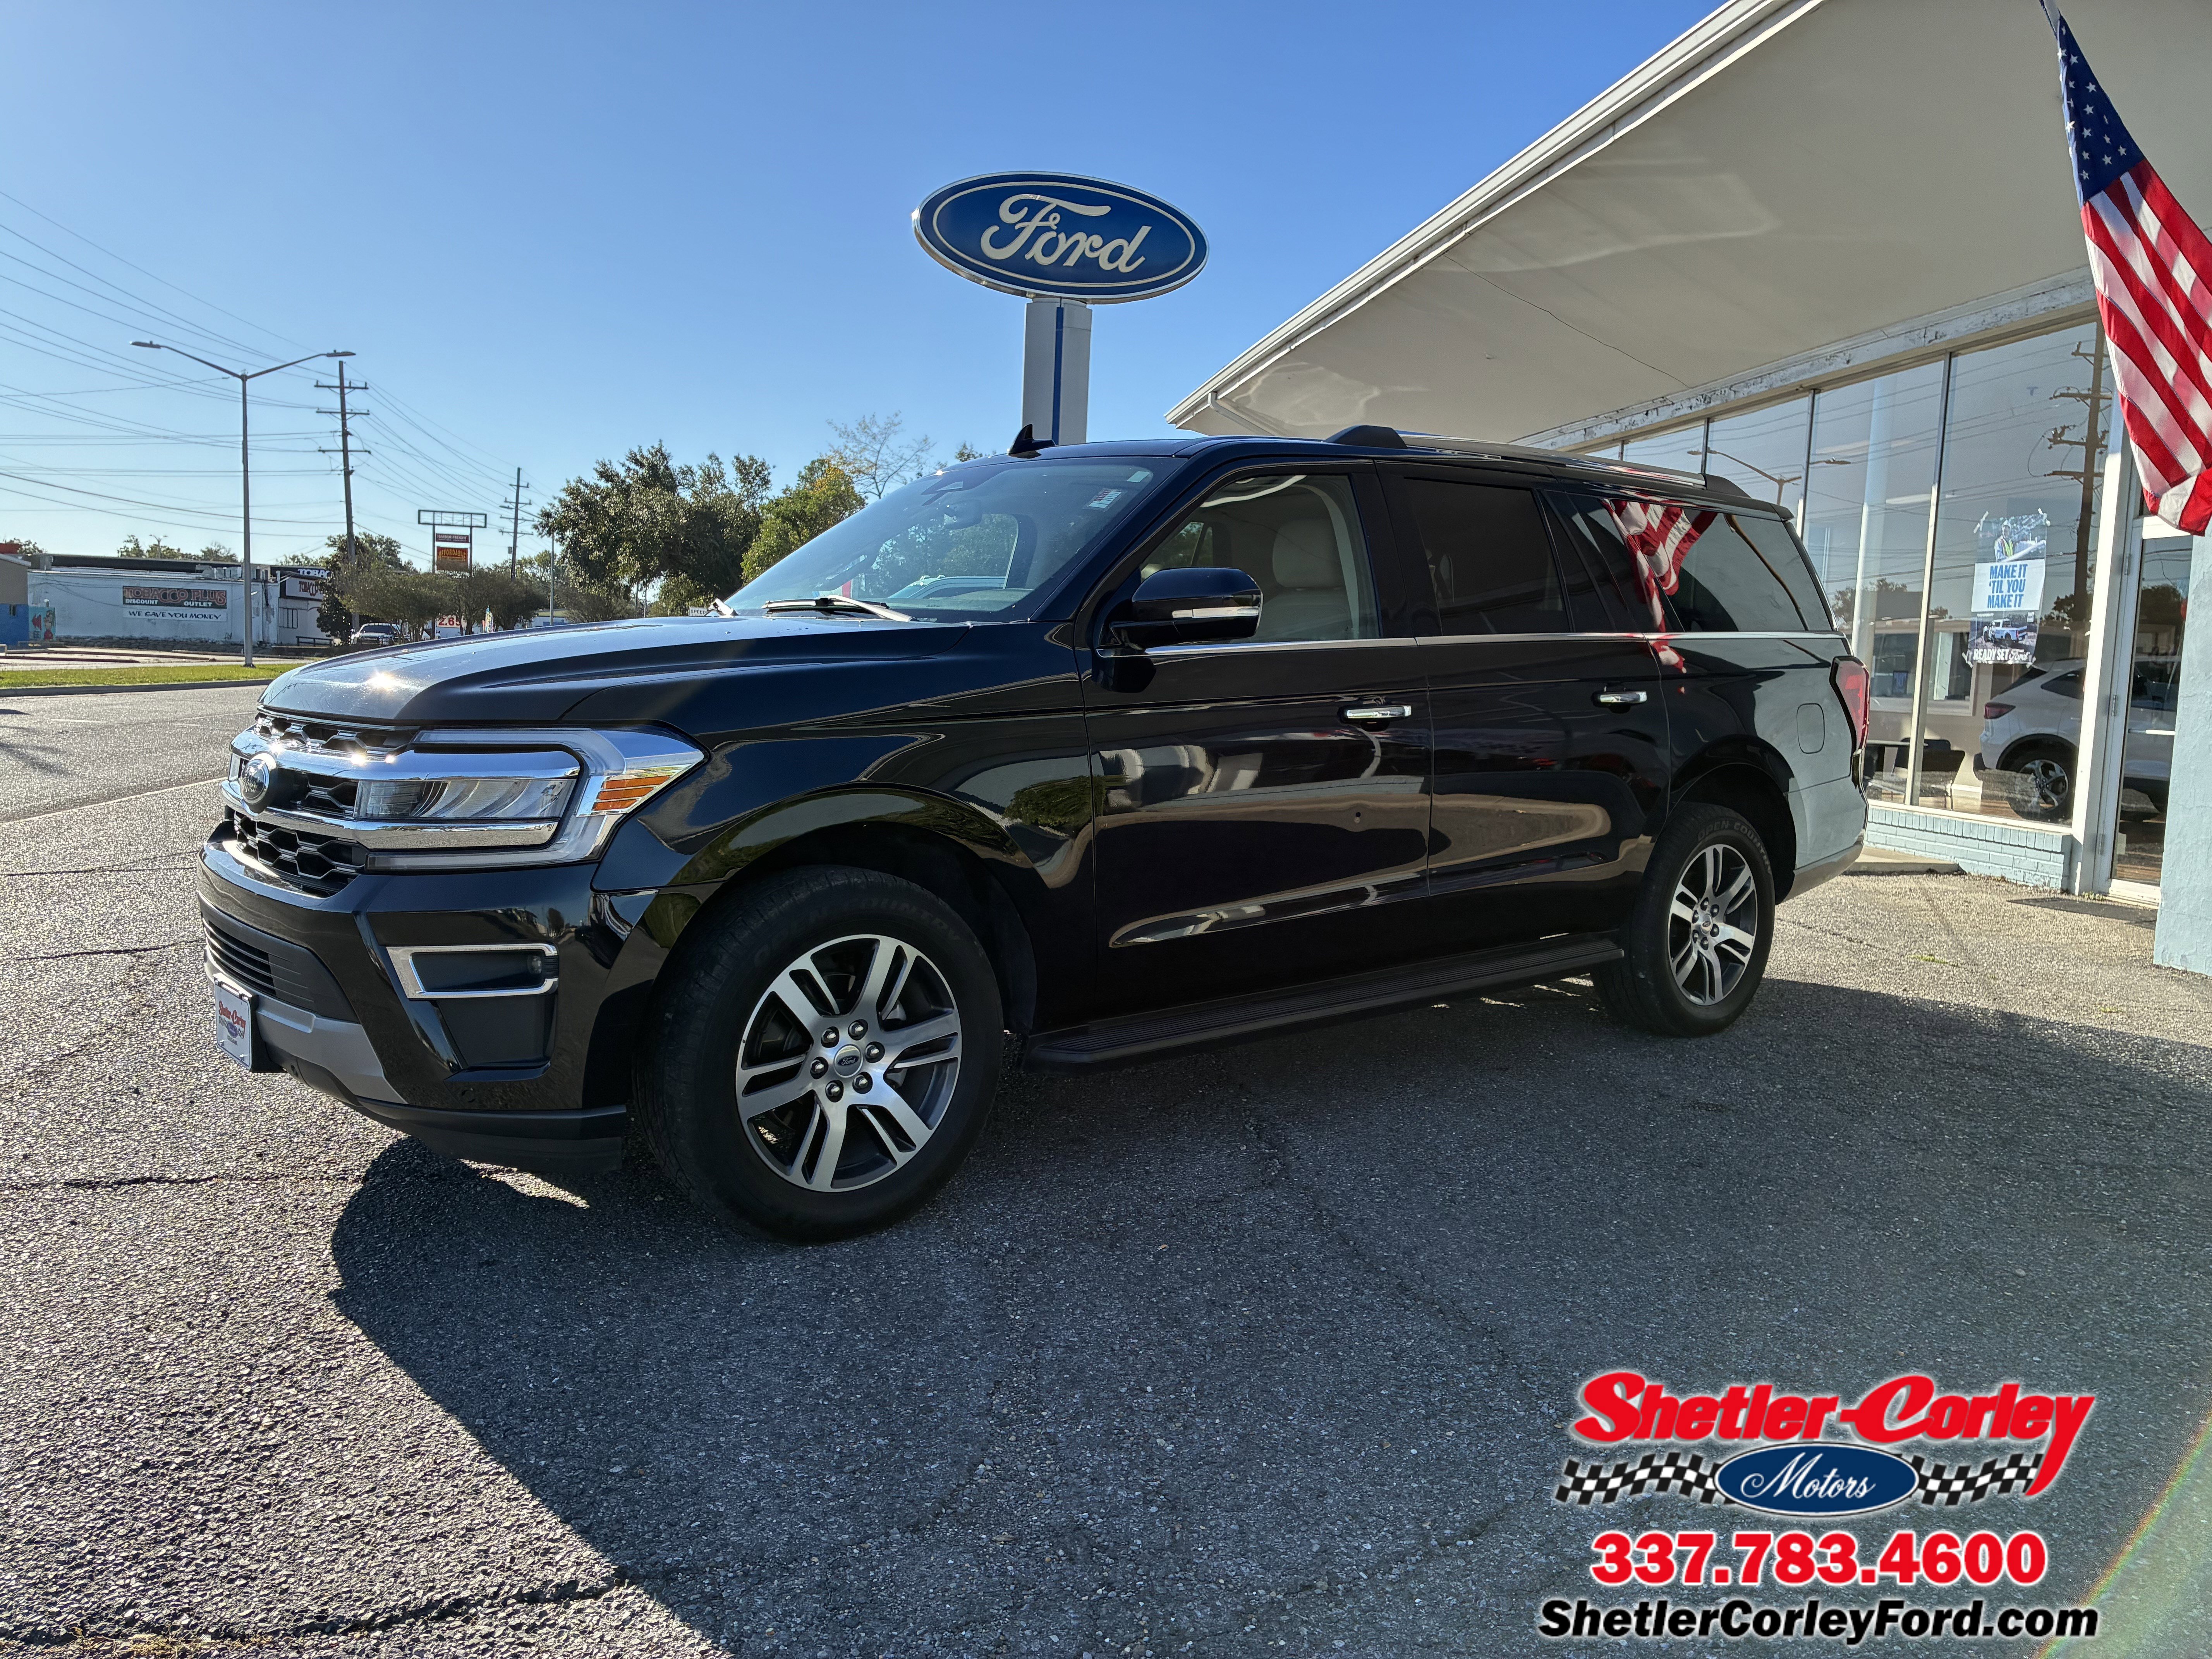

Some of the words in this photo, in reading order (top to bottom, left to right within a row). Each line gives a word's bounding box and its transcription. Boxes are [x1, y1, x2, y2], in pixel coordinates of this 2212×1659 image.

[981, 194, 1152, 273] Ford
[438, 549, 466, 559] AFFORDABLE
[1990, 564, 2018, 579] MAKE
[2018, 563, 2028, 578] IT
[2007, 579, 2026, 592] YOU
[124, 587, 189, 603] TOBACCO
[191, 589, 226, 605] PLUS
[1987, 595, 2013, 608] MAKE
[2014, 594, 2023, 608] IT
[1973, 648, 1997, 660] READY
[1996, 648, 2010, 660] SET
[2009, 648, 2030, 661] Ford
[841, 1057, 856, 1065] Ford
